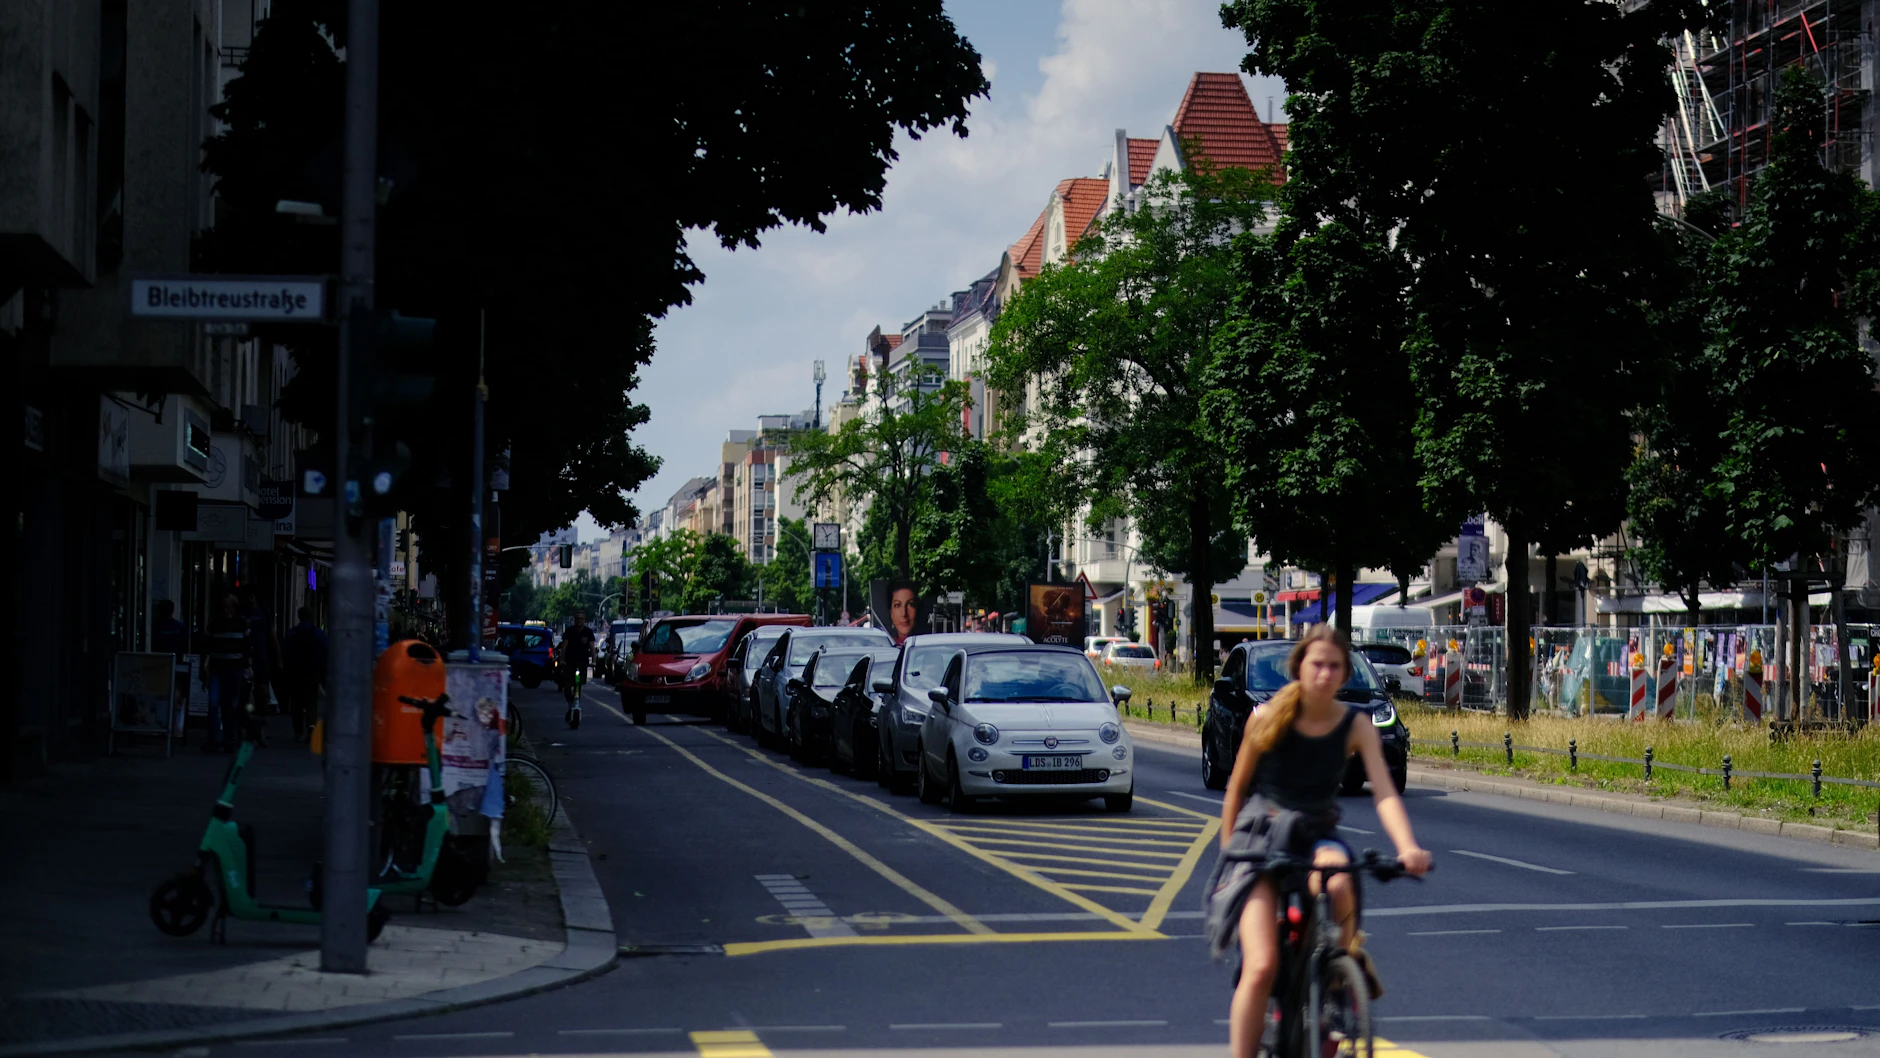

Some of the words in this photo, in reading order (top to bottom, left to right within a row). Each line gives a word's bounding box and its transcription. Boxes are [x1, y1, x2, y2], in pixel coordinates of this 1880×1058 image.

[147, 286, 308, 314] Bleibtreustraße
[258, 485, 281, 497] otel
[260, 495, 293, 506] ension
[1029, 757, 1047, 768] LDS
[1064, 756, 1081, 768] 296
